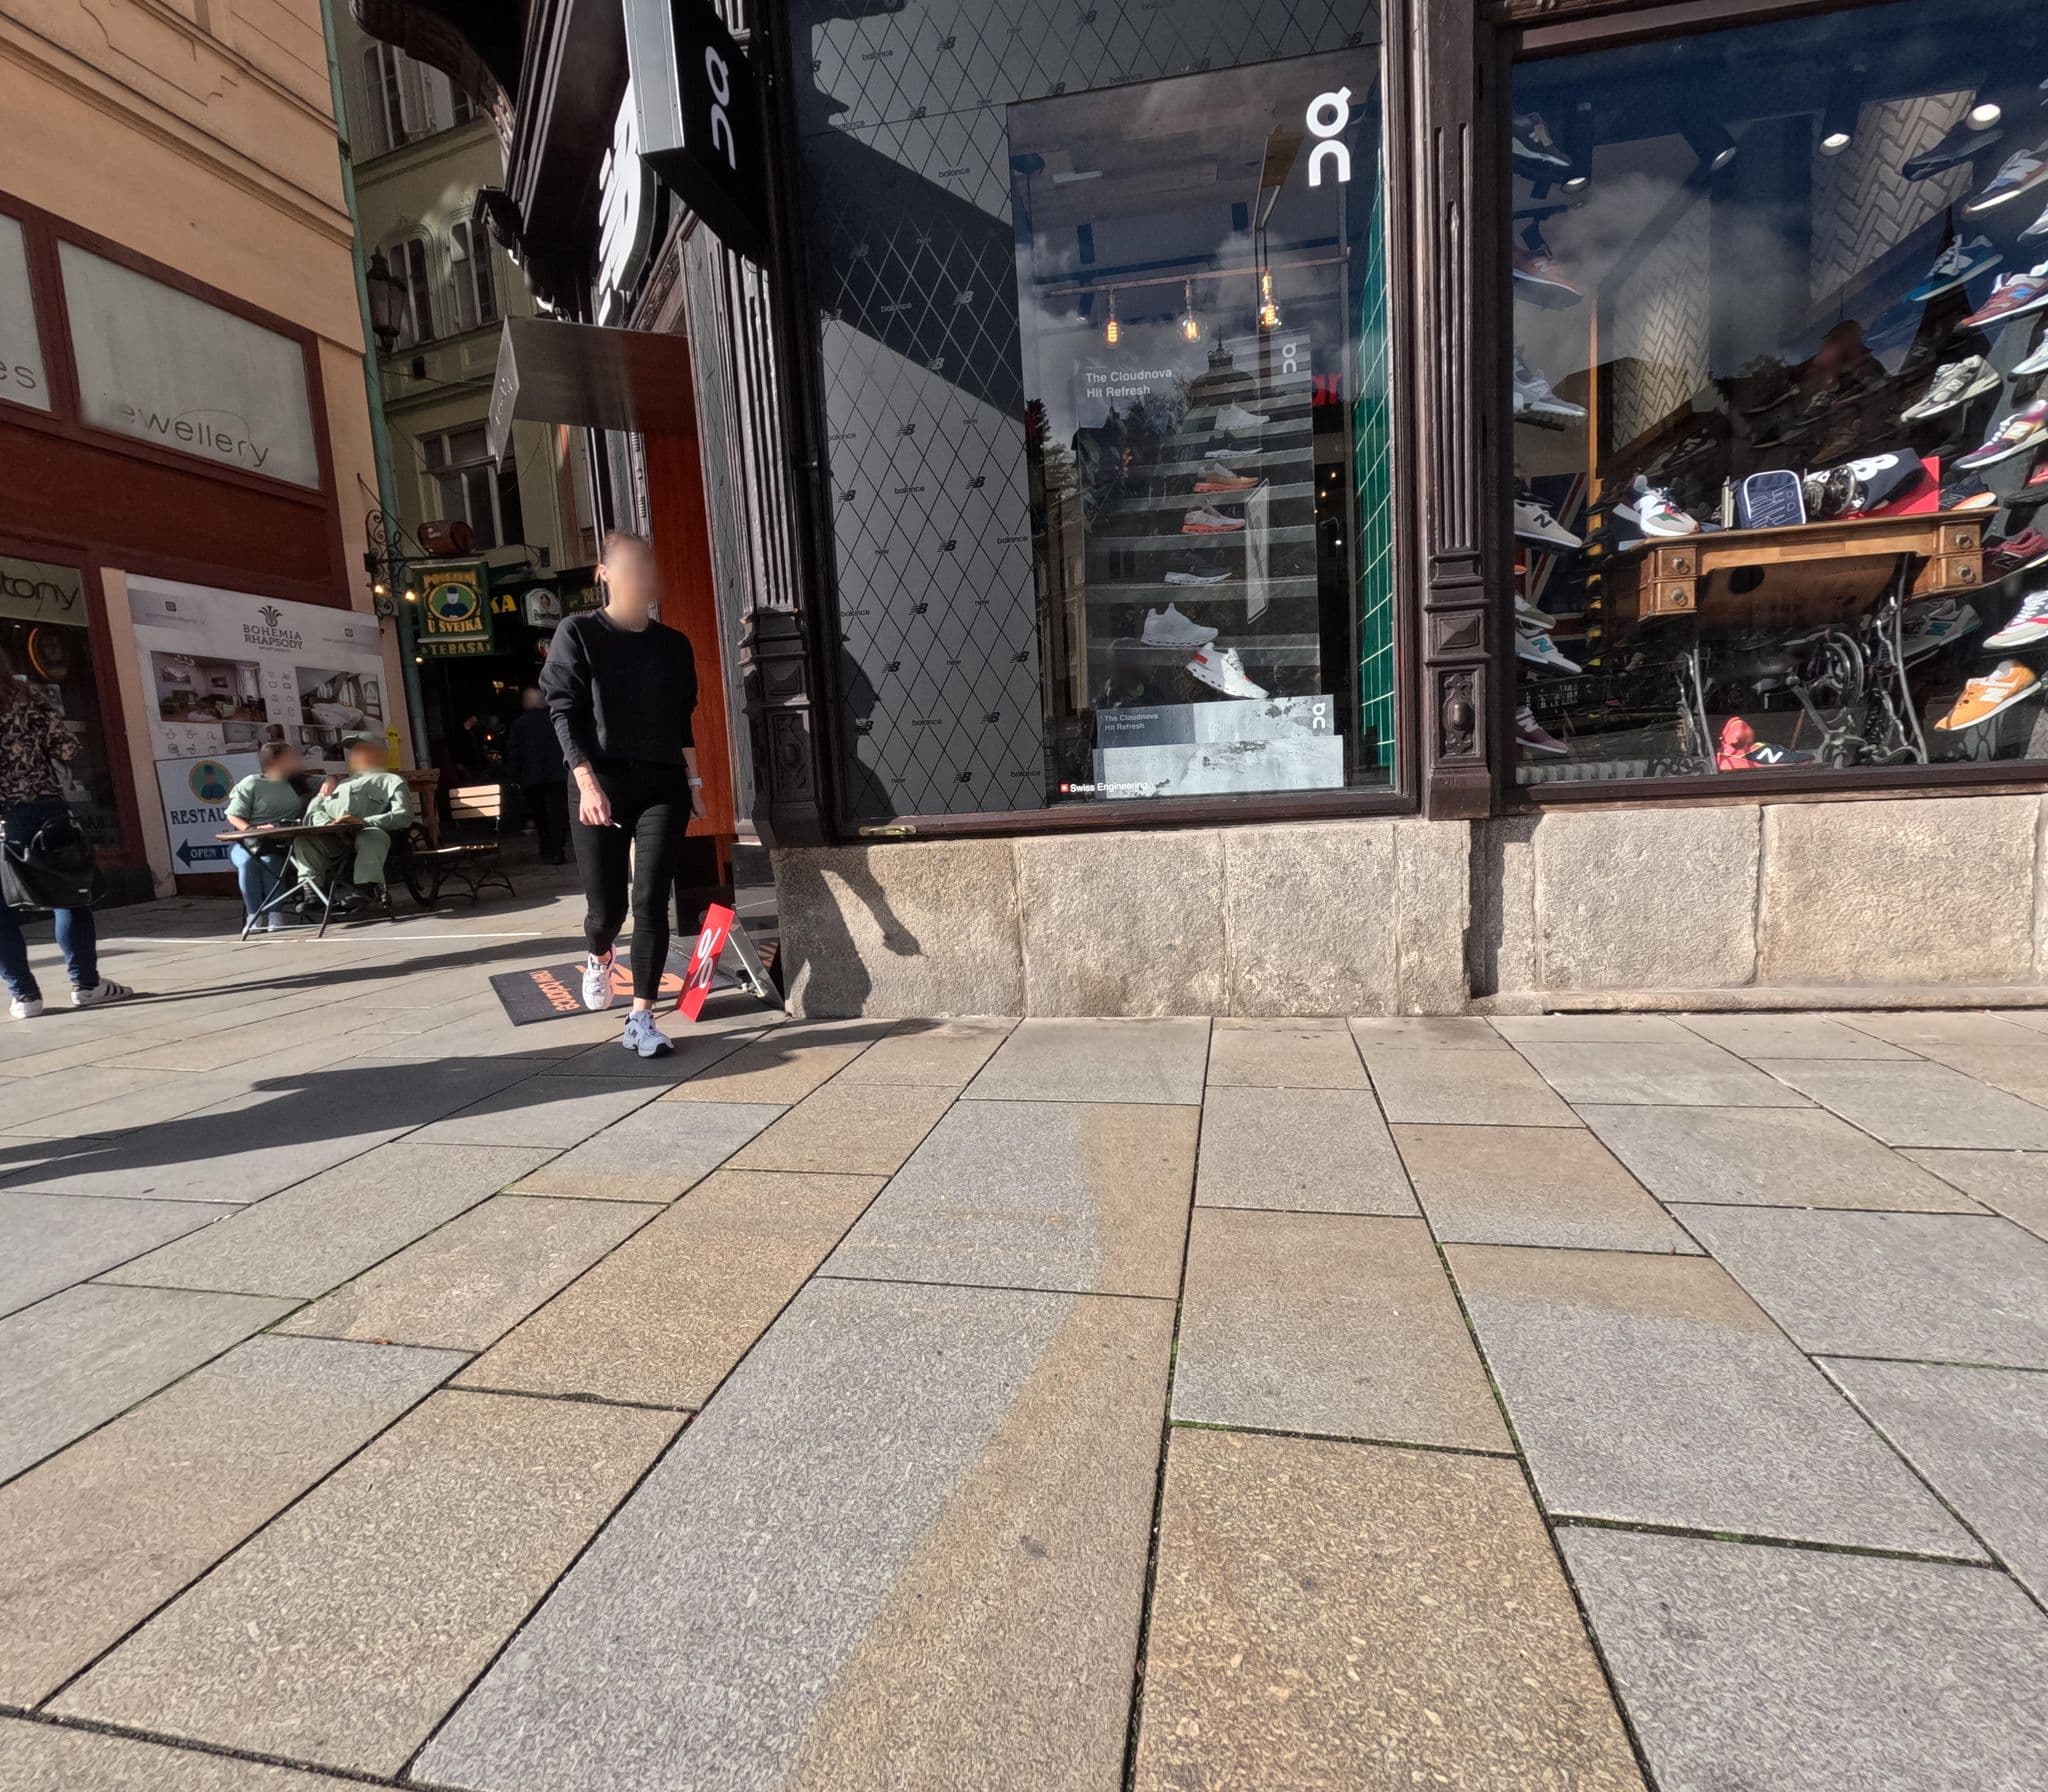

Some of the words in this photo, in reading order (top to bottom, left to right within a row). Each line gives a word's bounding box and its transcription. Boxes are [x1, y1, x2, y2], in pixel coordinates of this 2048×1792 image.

[939, 167, 970, 177] balance
[881, 303, 912, 312] balance
[1085, 372, 1107, 383] The
[1110, 368, 1173, 383] Cloudnova
[1086, 387, 1104, 399] Hit
[1108, 385, 1151, 398] Refresh
[894, 485, 925, 495] balance
[997, 535, 1028, 545] balance
[427, 619, 436, 633] U
[243, 624, 302, 640] BOHEMIA
[244, 633, 303, 650] RHAPSODY
[912, 718, 942, 726] balance
[1104, 714, 1117, 723] The
[1119, 712, 1158, 722] Cloudnova
[1116, 722, 1145, 730] Refresh
[1756, 747, 1783, 763] N
[1010, 769, 1041, 778] balance
[1070, 783, 1095, 792] Swiss
[1097, 780, 1148, 792] Engineering
